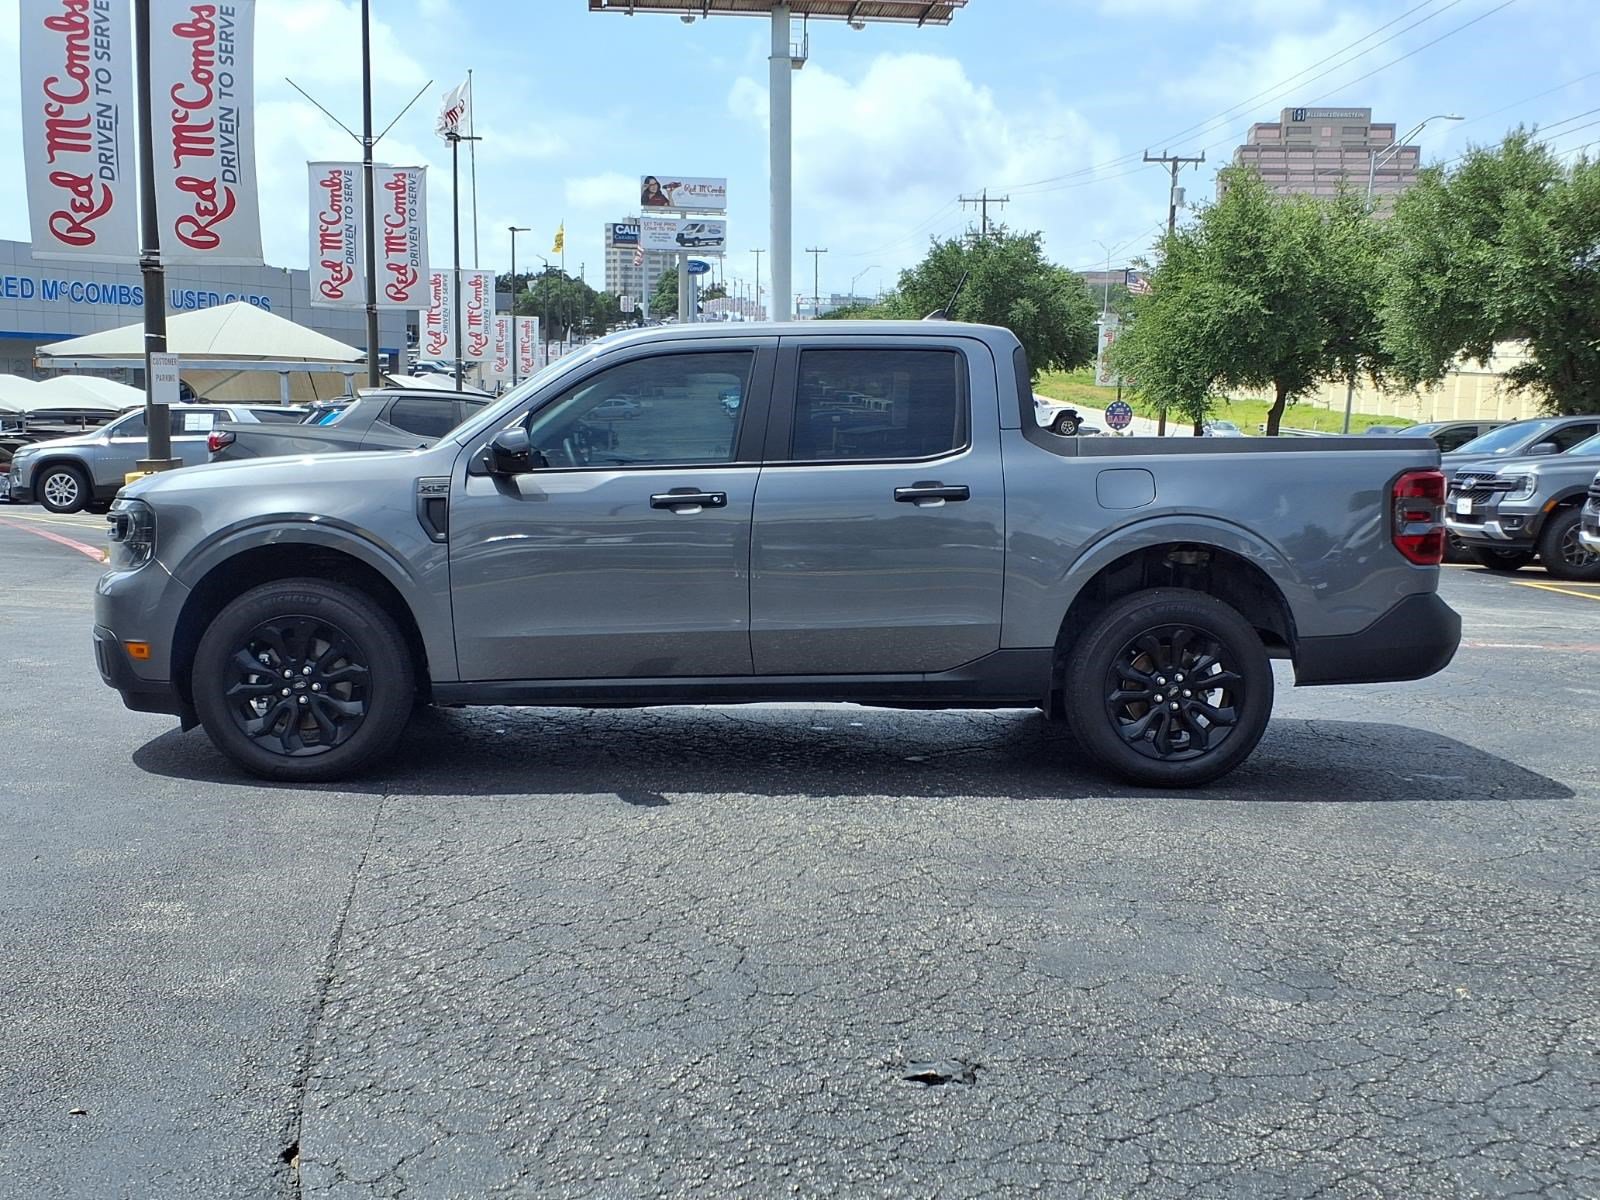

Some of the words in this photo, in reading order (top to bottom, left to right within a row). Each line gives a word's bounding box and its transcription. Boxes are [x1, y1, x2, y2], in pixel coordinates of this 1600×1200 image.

[93, 0, 111, 62] SERVE
[218, 4, 235, 68] SERVE
[96, 67, 112, 96] TO
[218, 72, 234, 100] TO
[96, 104, 115, 181] DRIVEN
[216, 106, 237, 184] DRIVEN
[344, 170, 352, 202] SERVE
[408, 173, 416, 206] SERVE
[48, 172, 113, 246] Red
[174, 176, 236, 250] Red
[345, 206, 353, 220] TO
[409, 208, 417, 222] TO
[345, 224, 354, 264] DRIVEN
[410, 226, 418, 267] DRIVEN
[320, 260, 353, 299] Red
[385, 263, 418, 302] Red
[172, 290, 220, 309] USED
[443, 296, 448, 306] TO
[426, 331, 447, 356] Red
[468, 332, 488, 356] Red
